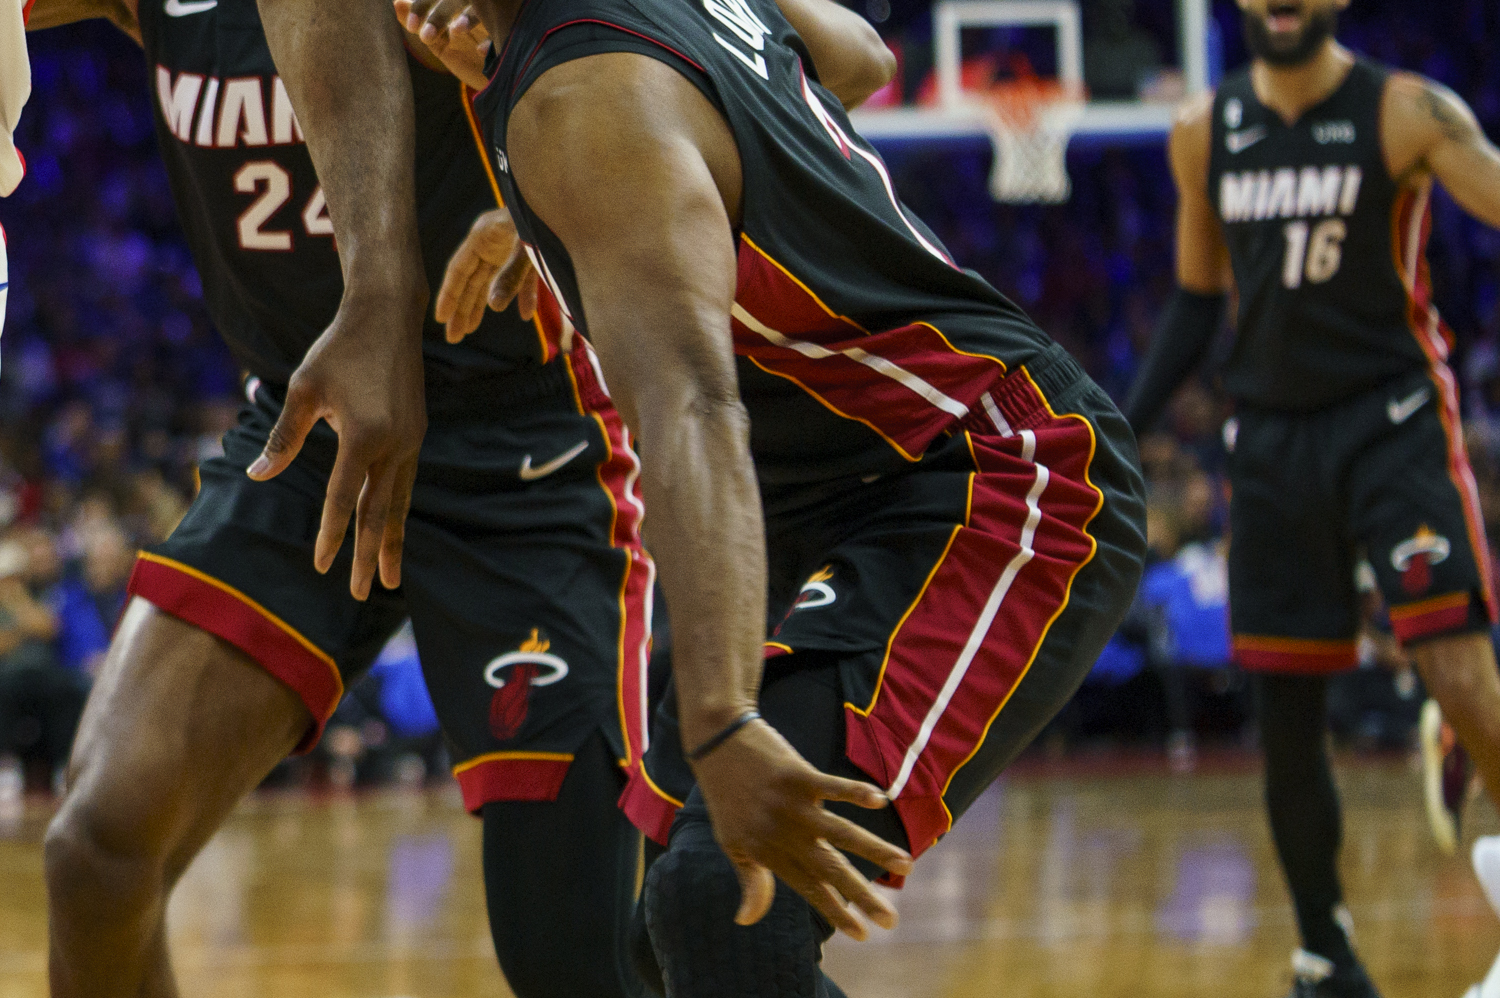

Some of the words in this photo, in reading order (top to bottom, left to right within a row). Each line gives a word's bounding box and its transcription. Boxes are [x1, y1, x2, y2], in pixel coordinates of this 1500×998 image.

[156, 64, 306, 149] MIA
[1219, 165, 1363, 223] MIAMI
[1282, 218, 1347, 289] 16
